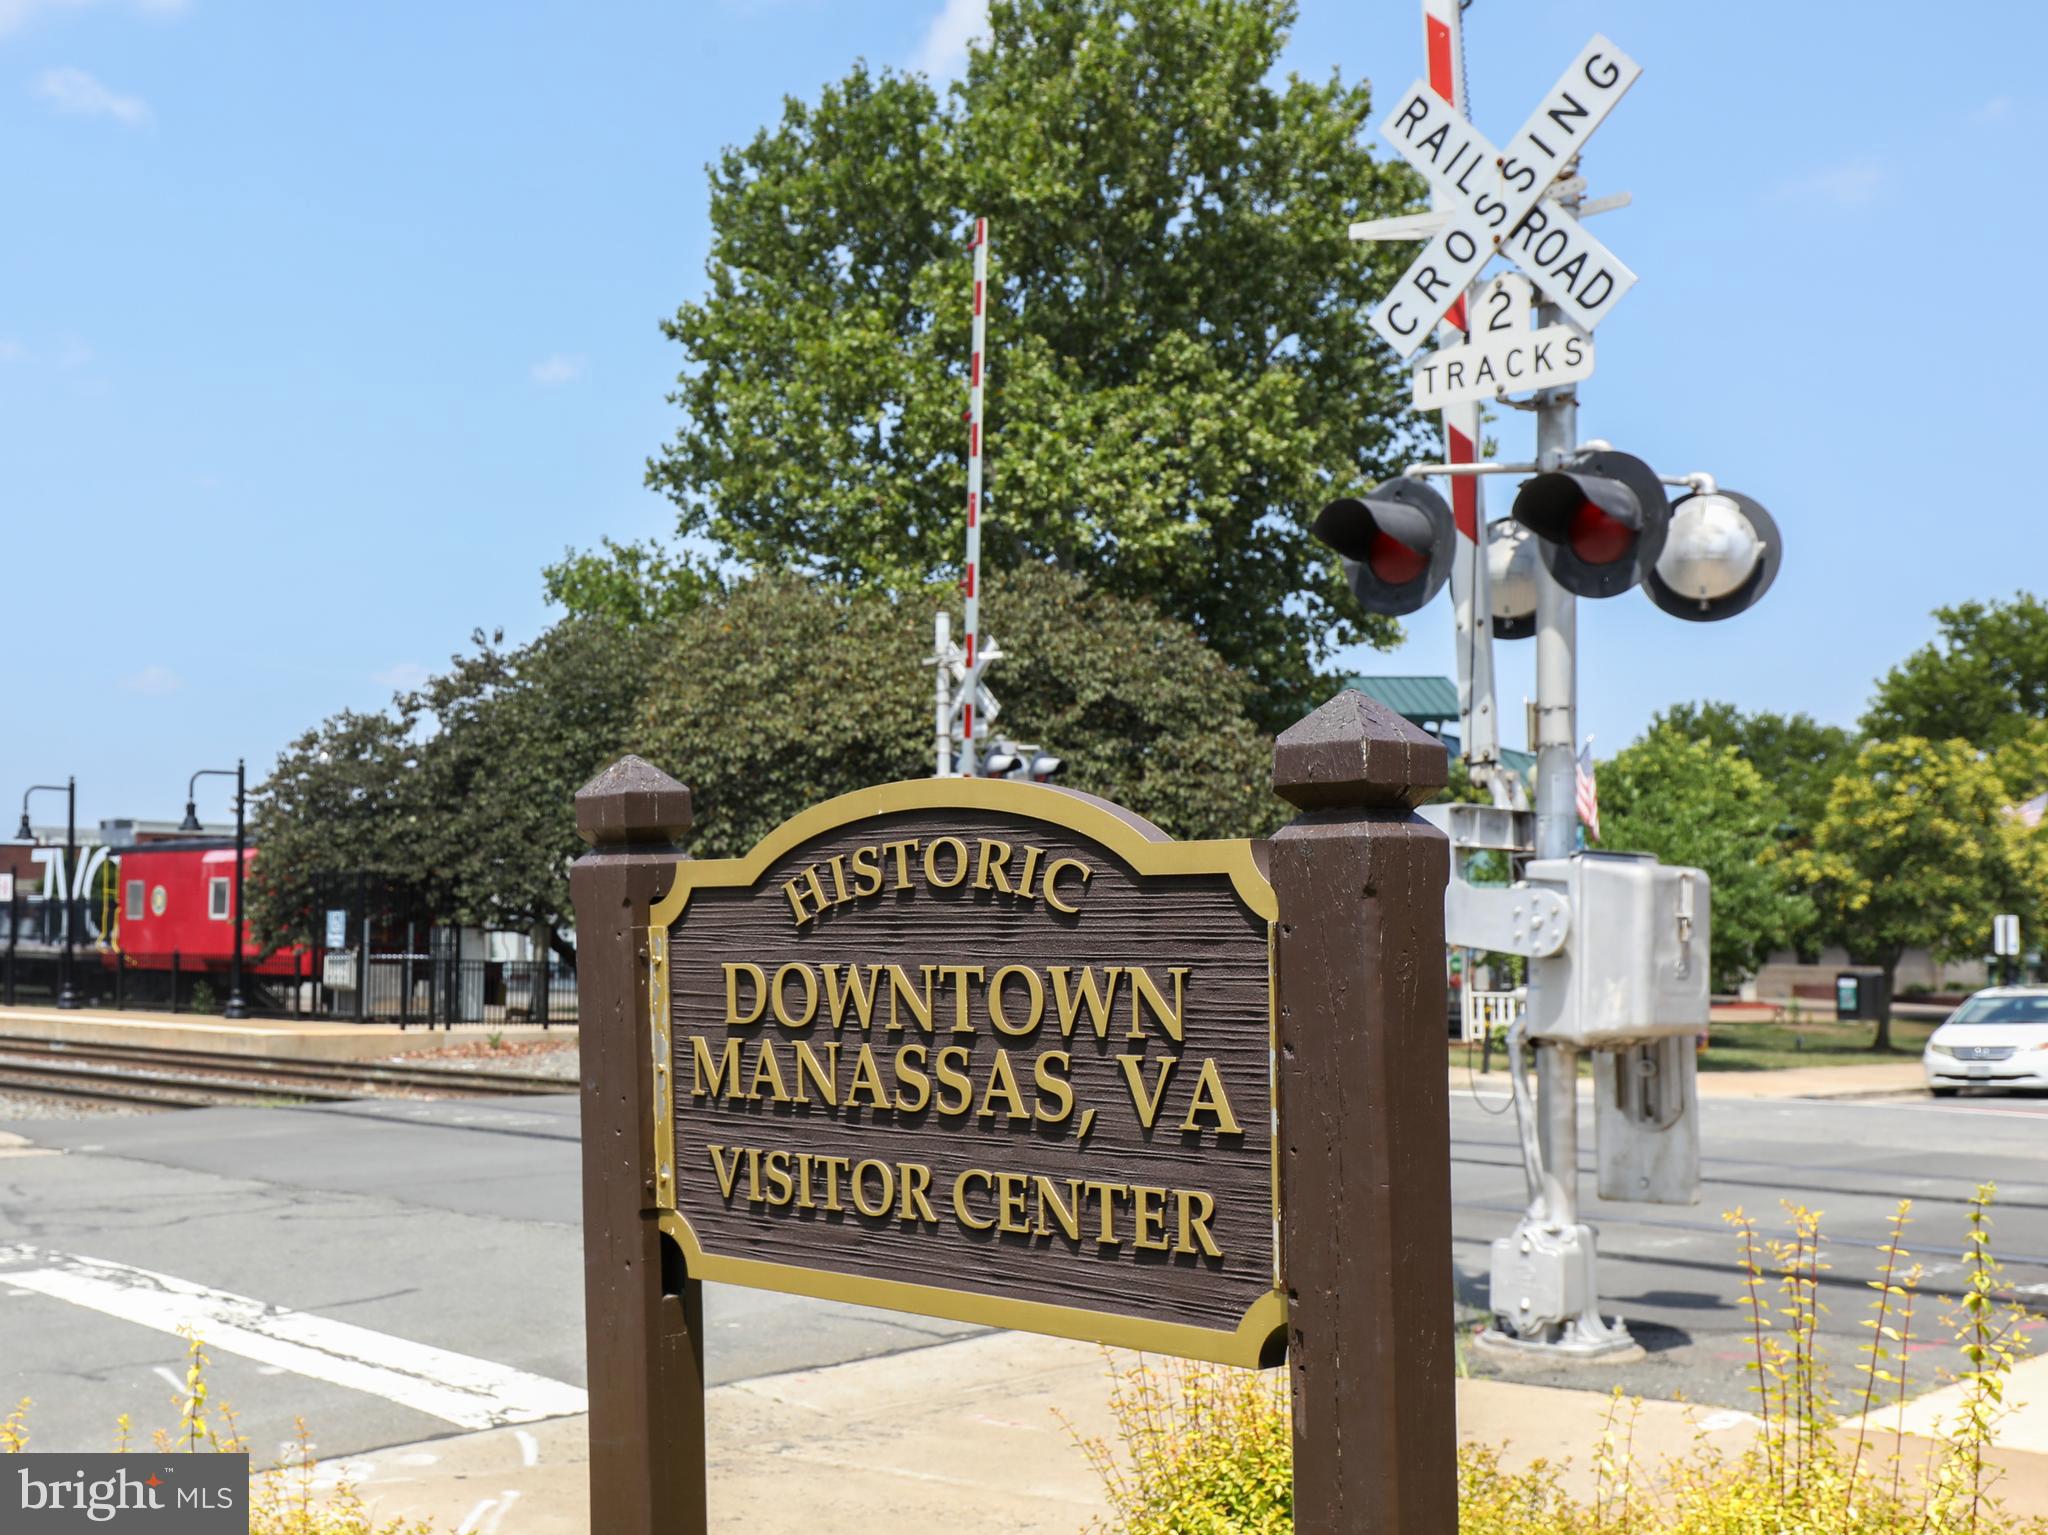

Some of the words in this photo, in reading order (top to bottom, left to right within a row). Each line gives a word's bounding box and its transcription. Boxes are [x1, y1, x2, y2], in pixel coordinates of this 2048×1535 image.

[1387, 53, 1620, 336] CROSSING
[1488, 291, 1512, 332] 2
[1423, 337, 1583, 394] TRACKS
[782, 836, 1094, 926] HISTORIC
[721, 962, 1192, 1042] DOWNTOWN
[689, 1035, 1096, 1139] MANASSAS,
[1116, 1054, 1245, 1135] VA
[707, 1144, 940, 1224] VISITOR
[952, 1168, 1224, 1258] CENTER
